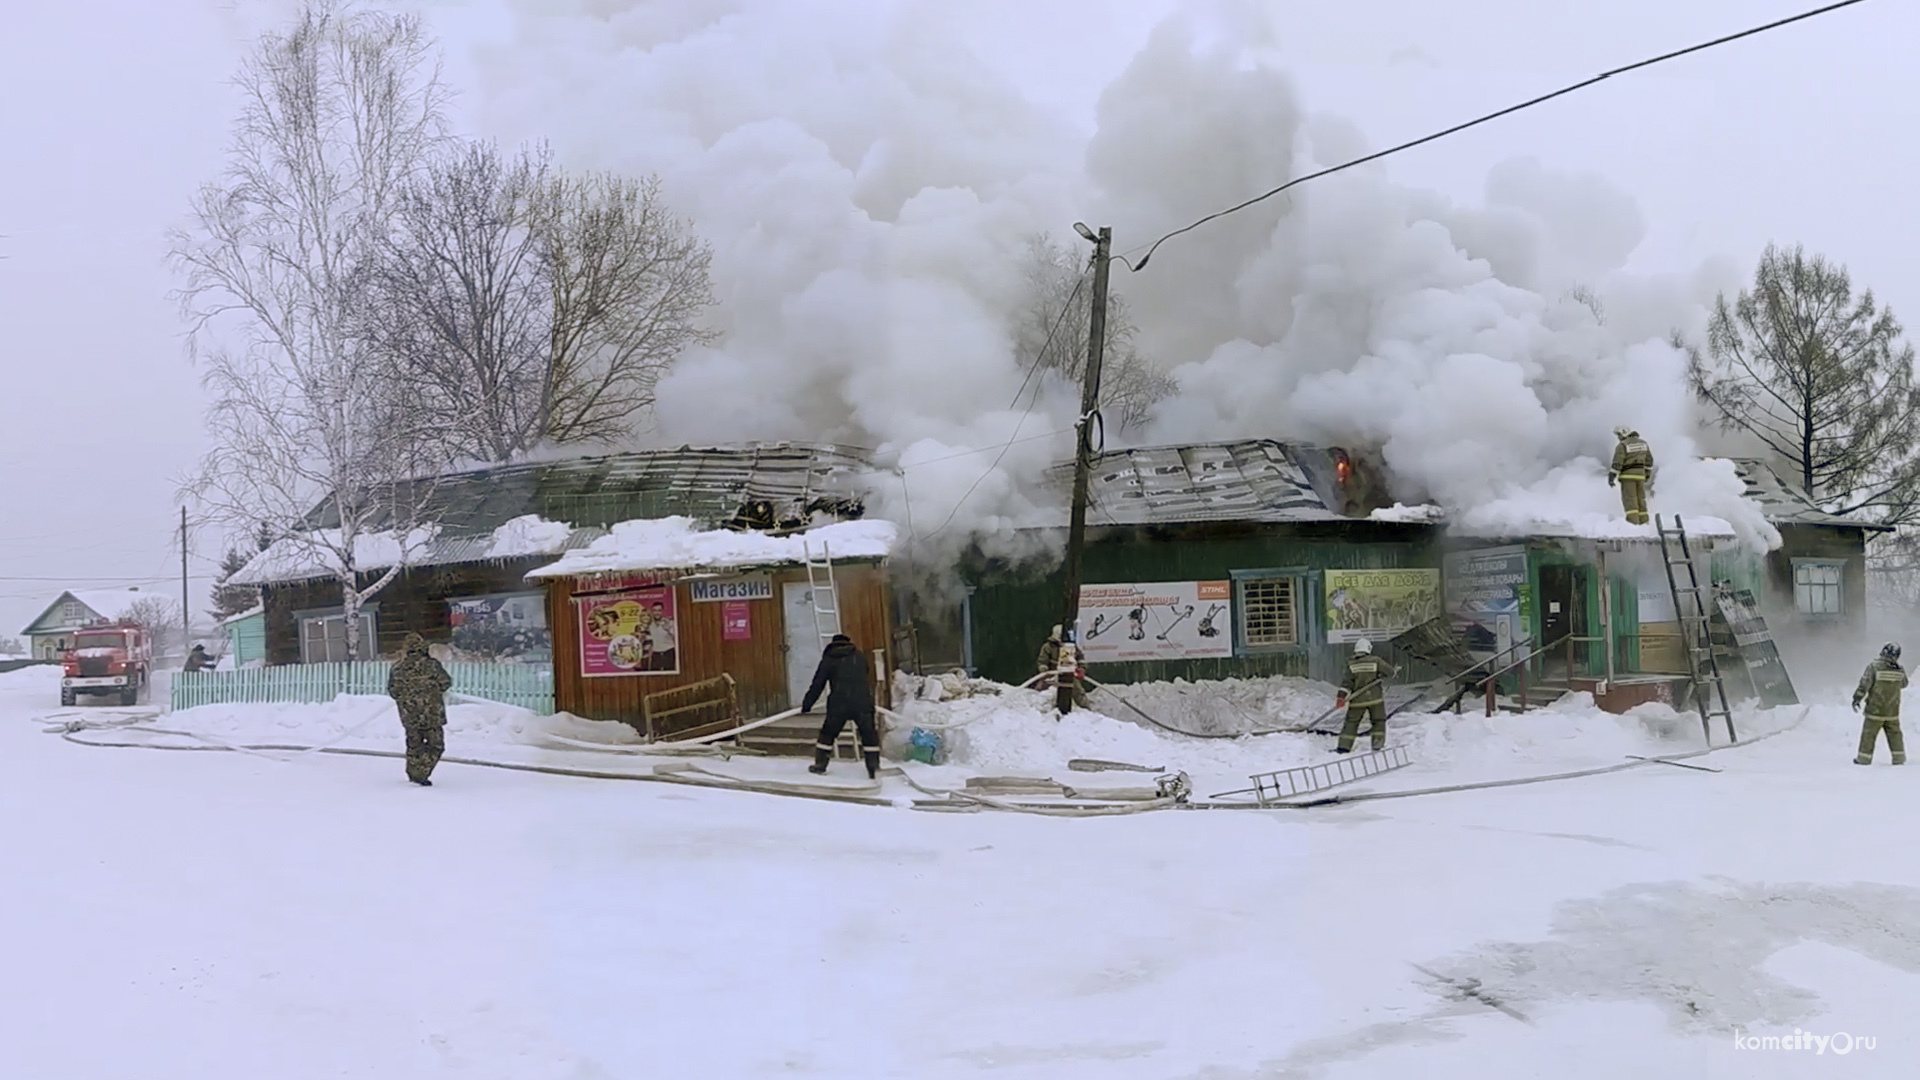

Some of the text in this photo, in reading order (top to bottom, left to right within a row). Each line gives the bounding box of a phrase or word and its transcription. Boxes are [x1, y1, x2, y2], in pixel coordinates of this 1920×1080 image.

[1363, 576, 1390, 587] ДЛЯ
[1394, 574, 1432, 587] ДОМА
[693, 581, 771, 599] Магазин
[1200, 586, 1226, 594] STIHL
